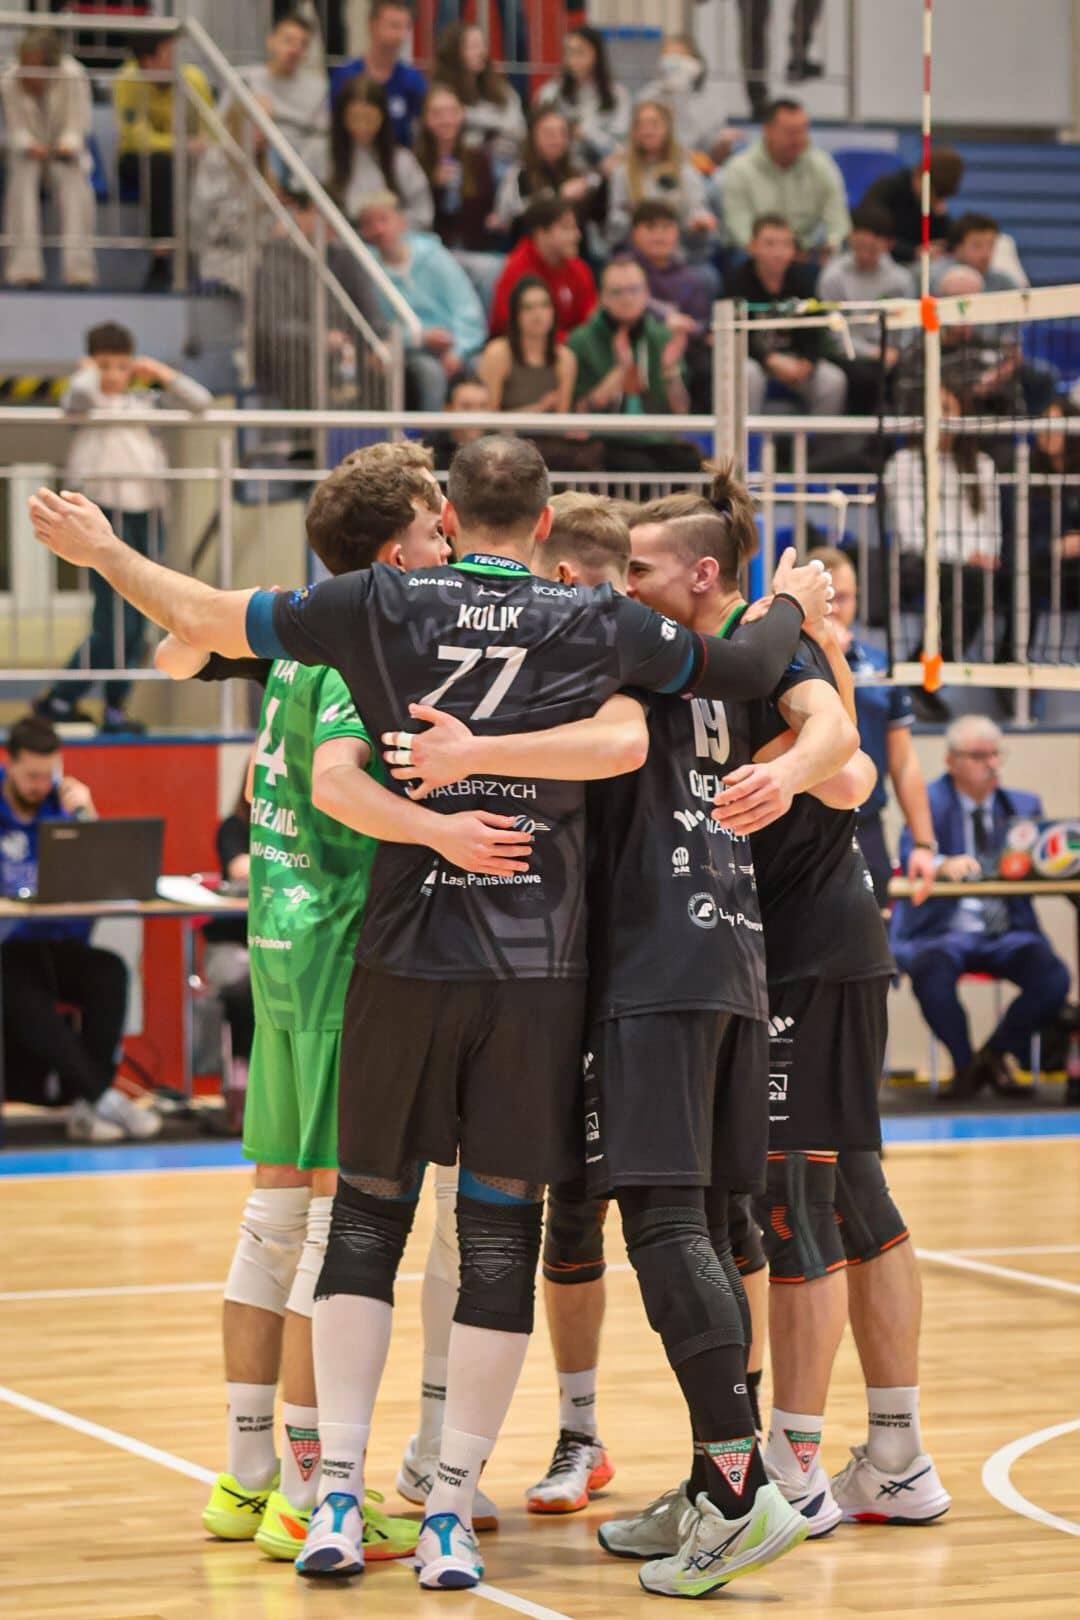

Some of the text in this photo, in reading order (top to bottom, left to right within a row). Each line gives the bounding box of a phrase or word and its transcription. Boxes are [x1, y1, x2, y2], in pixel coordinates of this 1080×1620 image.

[473, 554, 523, 571] TECHFIT
[419, 578, 463, 589] MABOR
[456, 603, 525, 632] KULIK
[419, 645, 528, 720] 77
[255, 696, 288, 786] 4
[690, 698, 730, 765] 19
[405, 780, 536, 799] AŁBRZYCH
